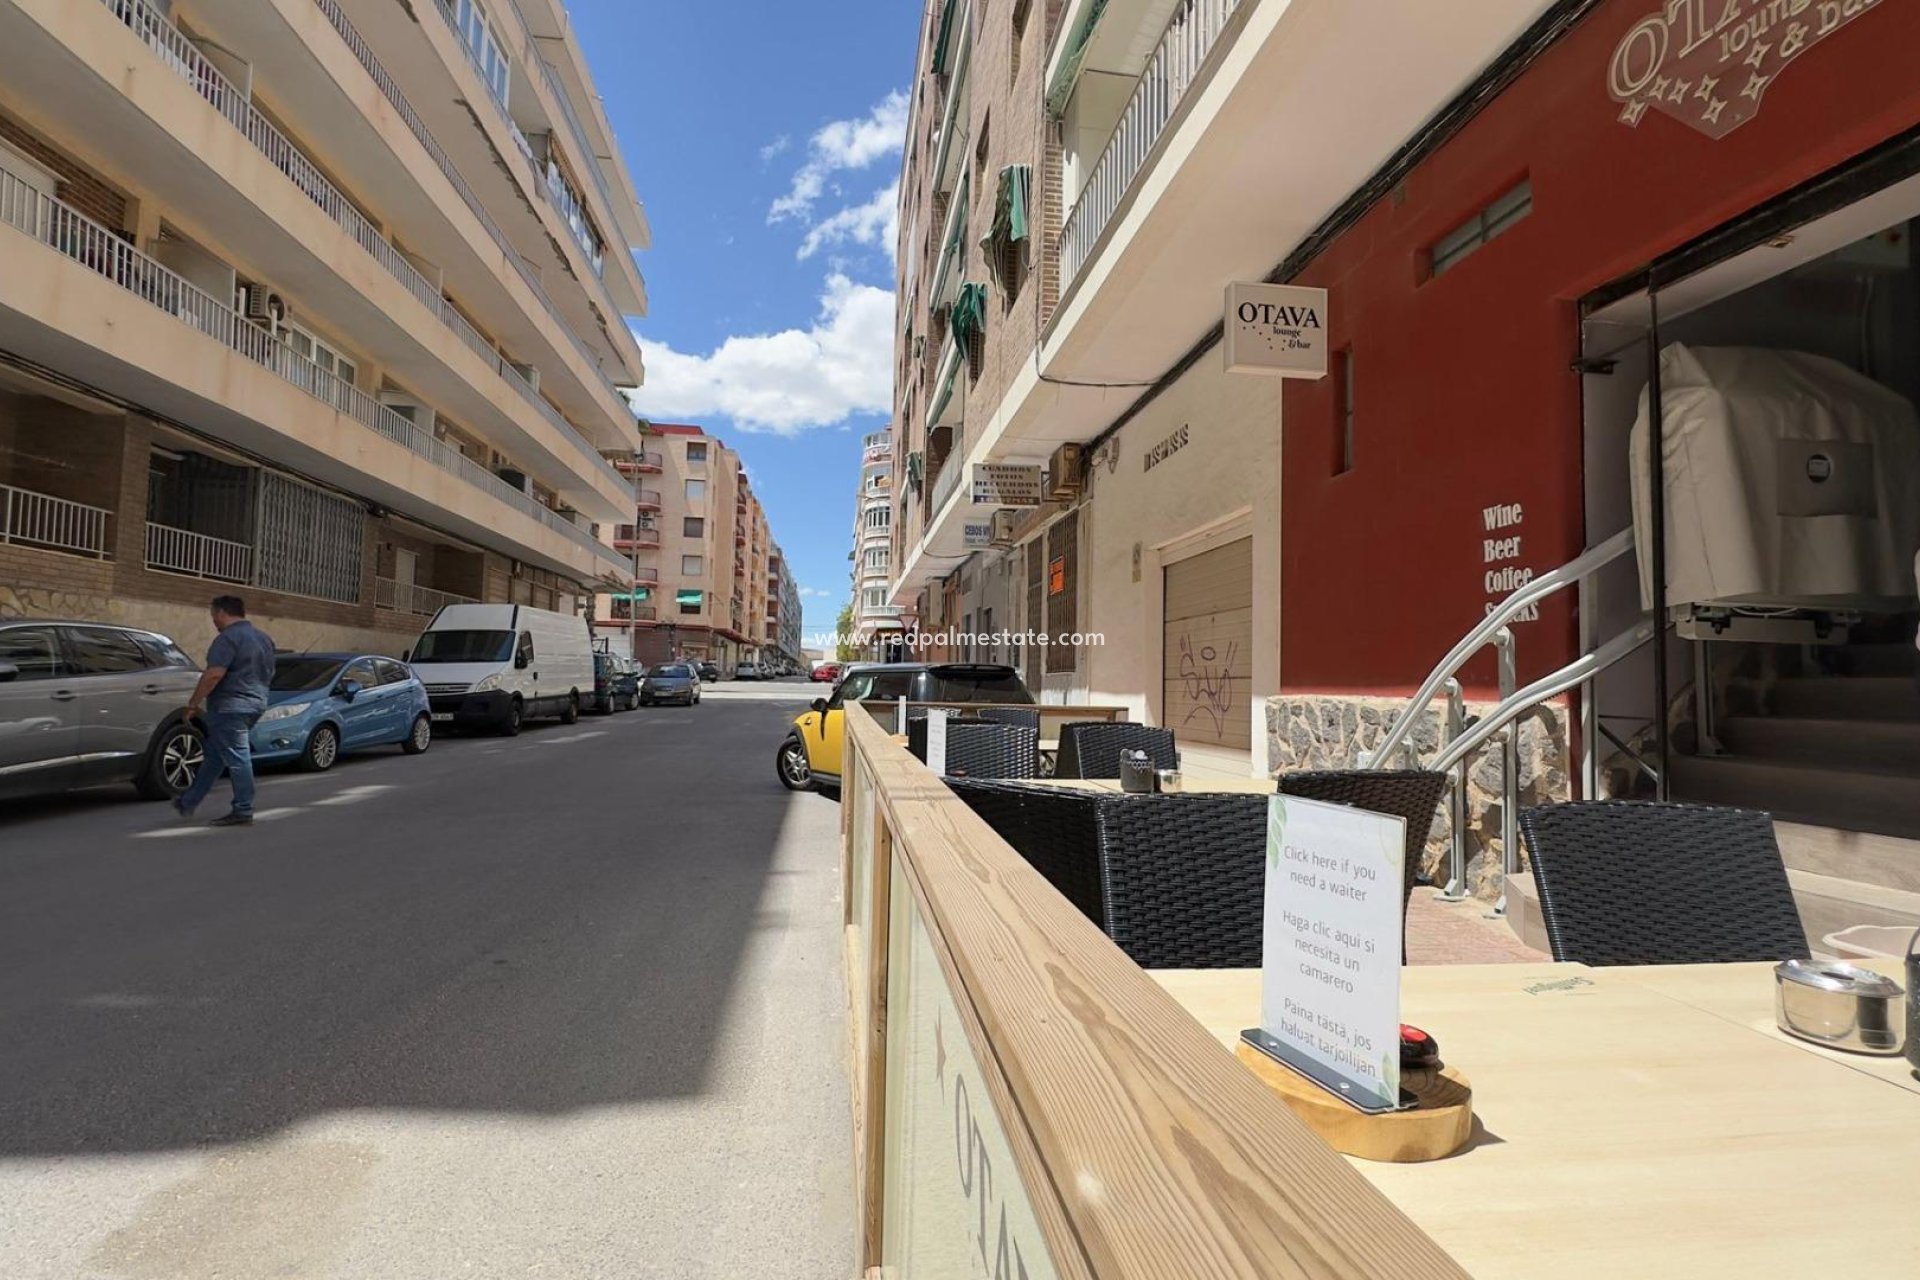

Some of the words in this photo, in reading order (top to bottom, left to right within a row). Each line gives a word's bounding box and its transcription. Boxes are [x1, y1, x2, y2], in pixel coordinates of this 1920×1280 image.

[1238, 302, 1320, 328] OTAVA
[1273, 326, 1301, 339] lounge
[1483, 503, 1523, 531] Wine
[1483, 536, 1521, 563] Beer
[1484, 566, 1533, 594] Coffee
[1284, 845, 1309, 863] Click
[1312, 851, 1337, 871] here
[1341, 858, 1349, 873] if
[1353, 864, 1376, 881] you
[1290, 871, 1316, 888] need
[1319, 880, 1326, 890] a
[1329, 882, 1367, 901] waiter
[1283, 910, 1310, 932] Haga
[1313, 920, 1331, 938] clic
[1364, 938, 1375, 954] si
[1295, 938, 1341, 965] necesita
[1344, 957, 1360, 972] un
[1300, 962, 1354, 993] camarero
[1284, 997, 1313, 1022] Paina
[1354, 1029, 1372, 1051] jos
[1281, 1017, 1315, 1047] haluat
[1318, 1037, 1376, 1077] tarjoilijan
